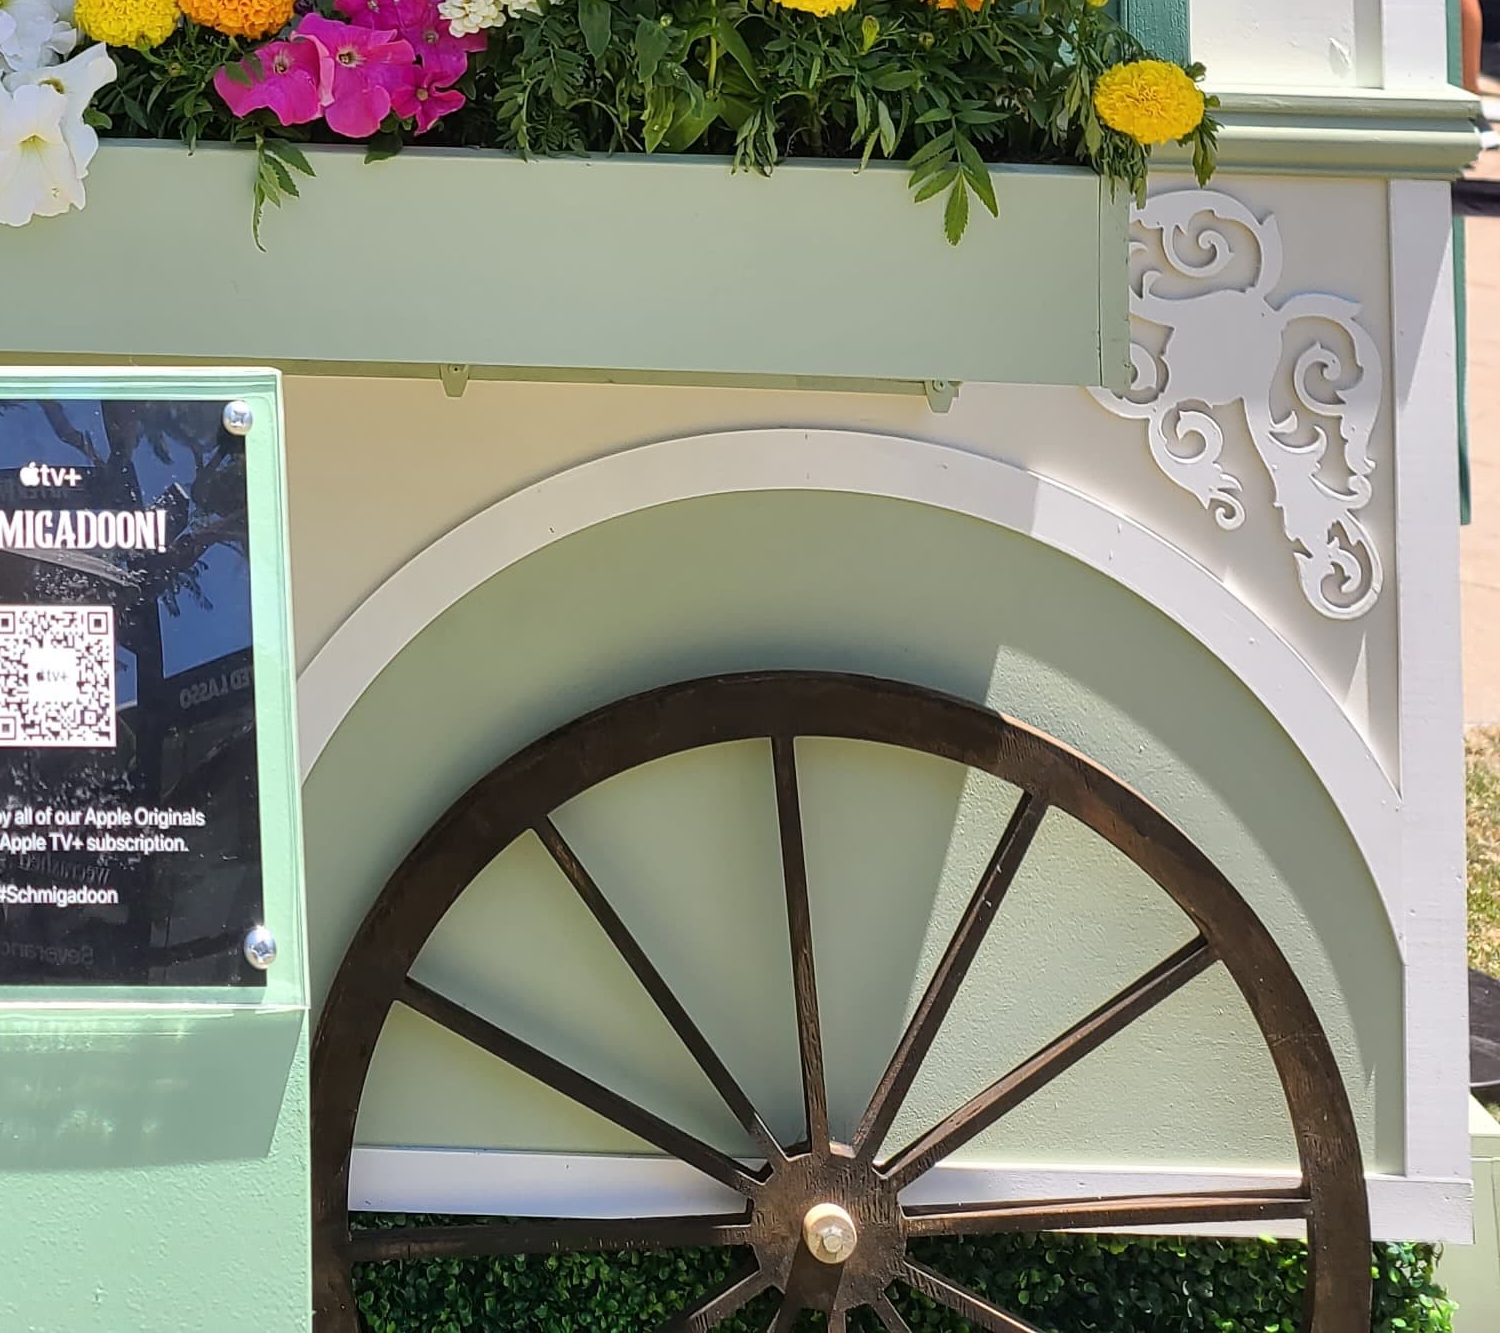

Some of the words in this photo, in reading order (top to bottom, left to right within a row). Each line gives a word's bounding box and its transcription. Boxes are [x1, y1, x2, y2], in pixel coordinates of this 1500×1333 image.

[39, 467, 83, 487] tv+
[14, 806, 33, 826] all
[35, 806, 52, 826] of
[54, 810, 82, 826] our
[84, 806, 132, 829] Apple
[134, 806, 206, 829] Originals
[0, 832, 47, 854] Apple
[49, 832, 84, 851] TV+
[86, 833, 190, 855] subscription.
